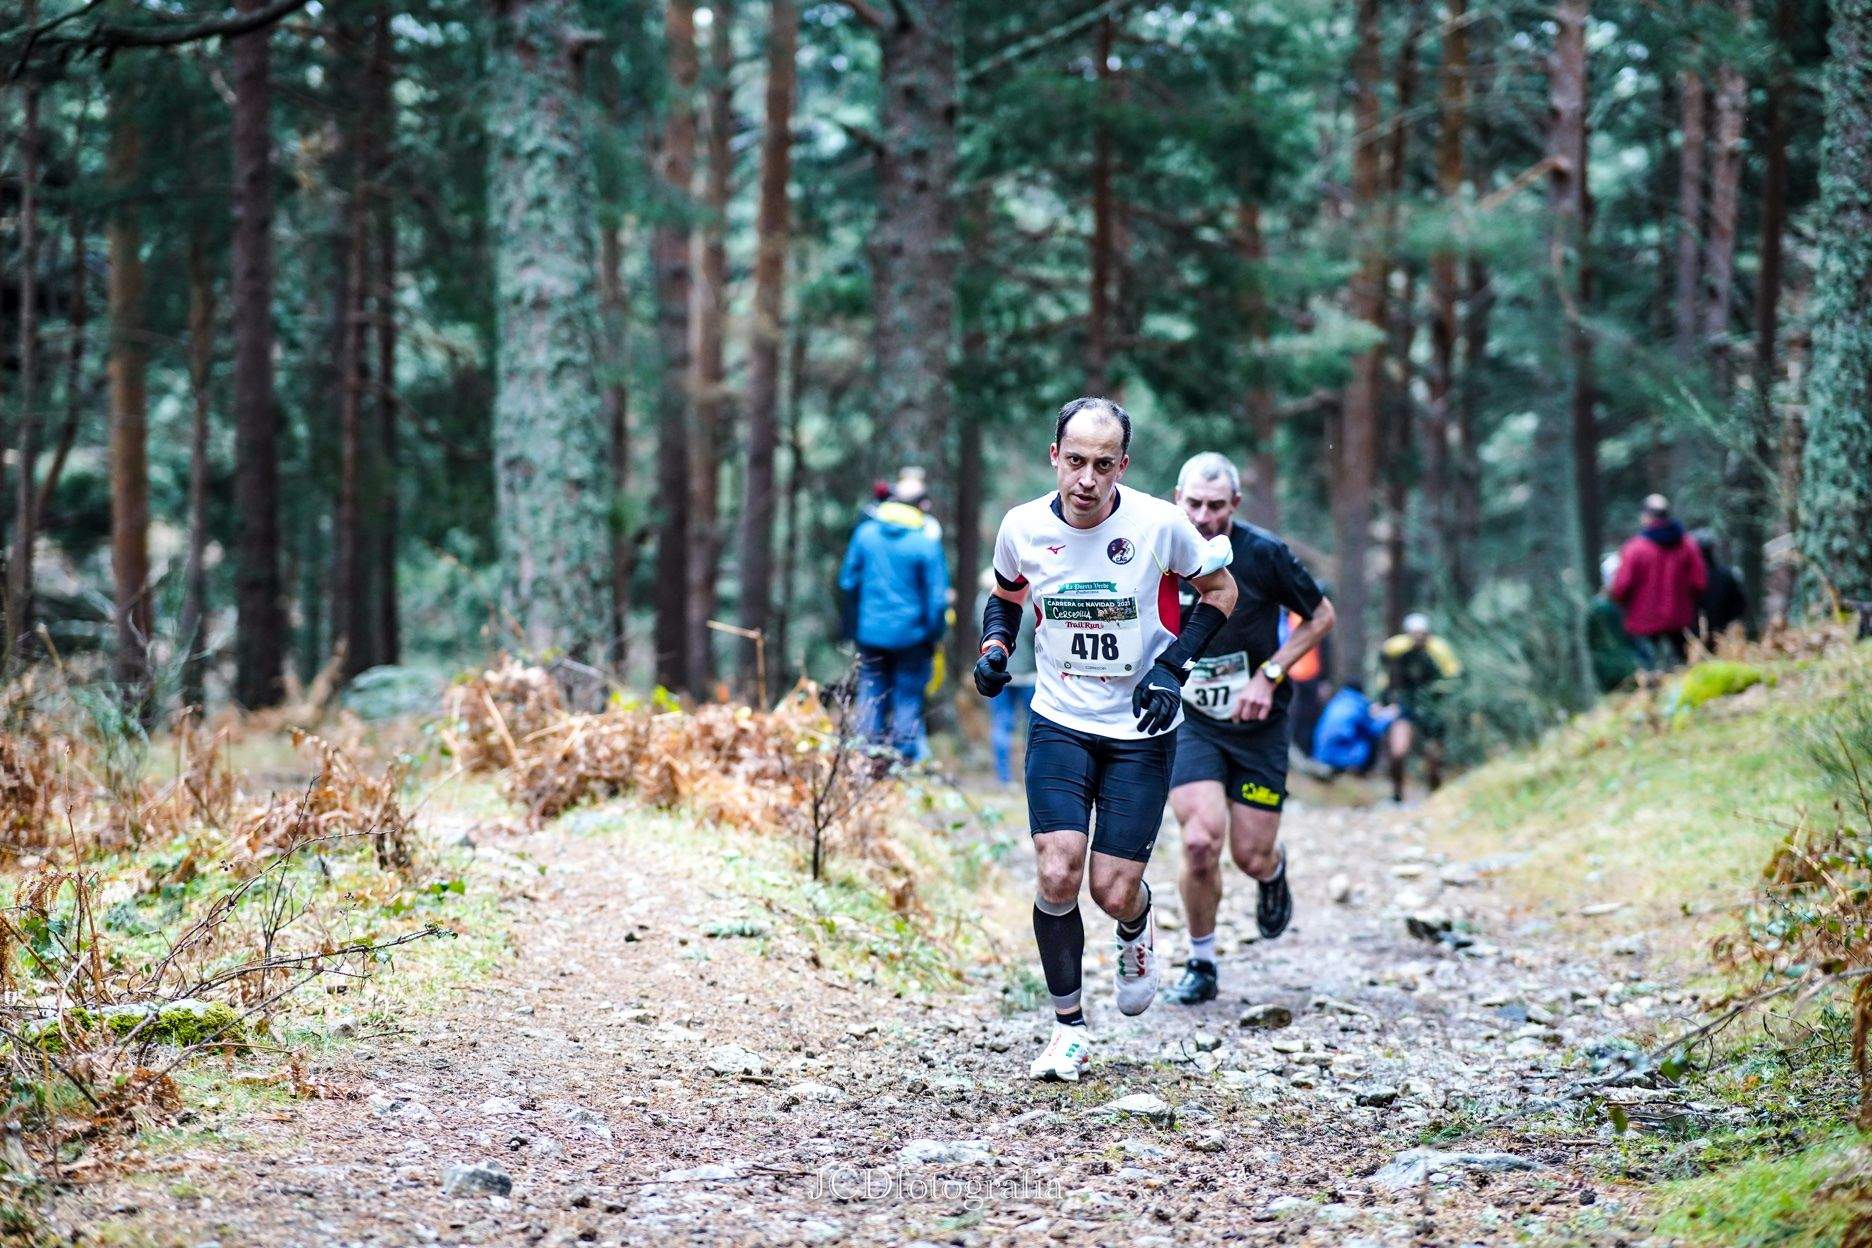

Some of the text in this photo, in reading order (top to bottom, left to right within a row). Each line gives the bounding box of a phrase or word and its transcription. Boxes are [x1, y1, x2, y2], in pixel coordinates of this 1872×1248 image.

[1047, 600, 1077, 608] CARRERA
[1065, 621, 1100, 630] Trail Run
[1071, 633, 1119, 661] 478
[1195, 686, 1230, 707] 377
